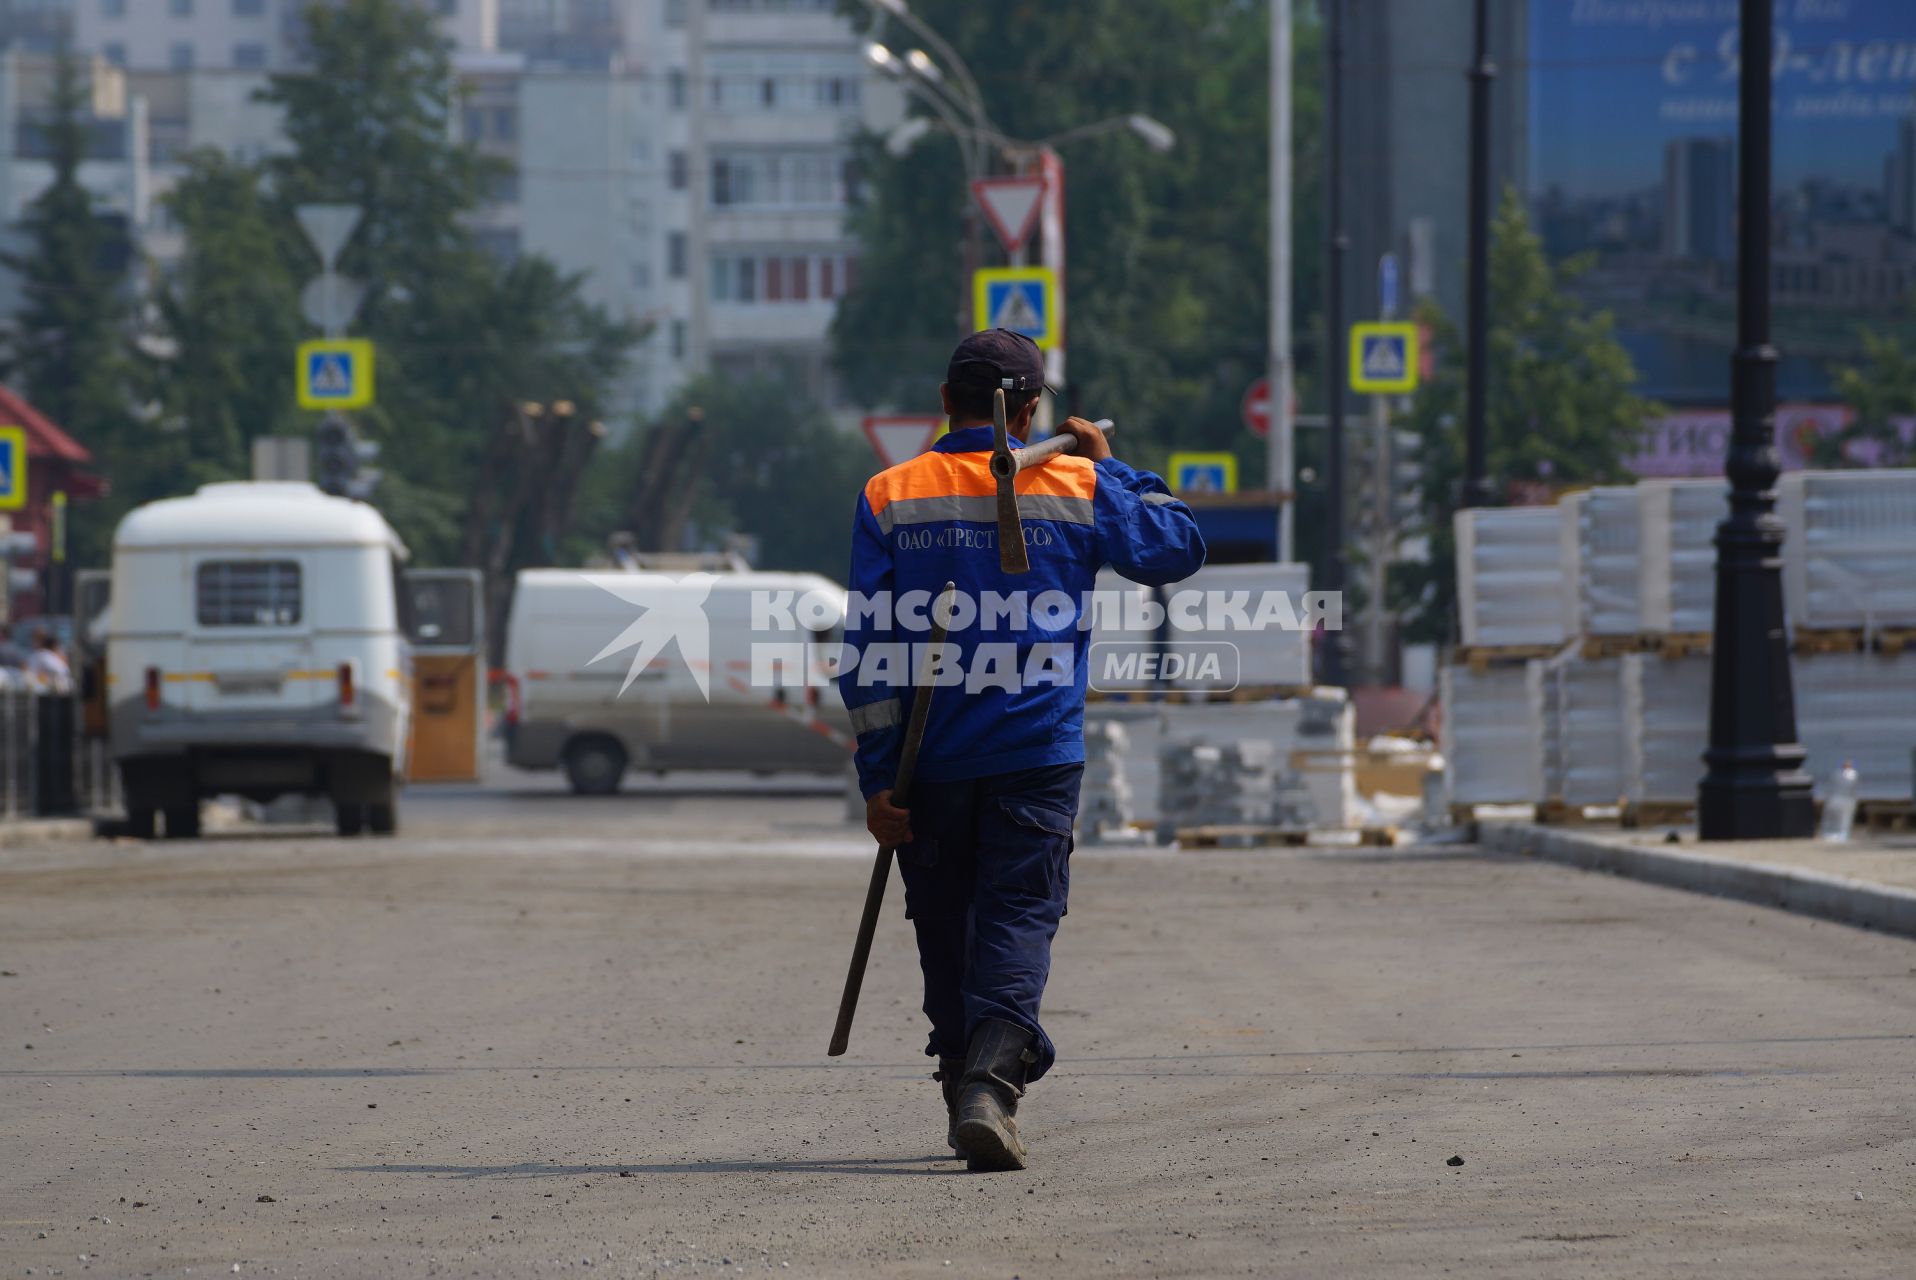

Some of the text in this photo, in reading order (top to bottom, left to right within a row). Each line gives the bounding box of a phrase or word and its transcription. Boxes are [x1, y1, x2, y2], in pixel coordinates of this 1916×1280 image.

[897, 526, 1053, 551] ОАО «ТРЕСТ СС»
